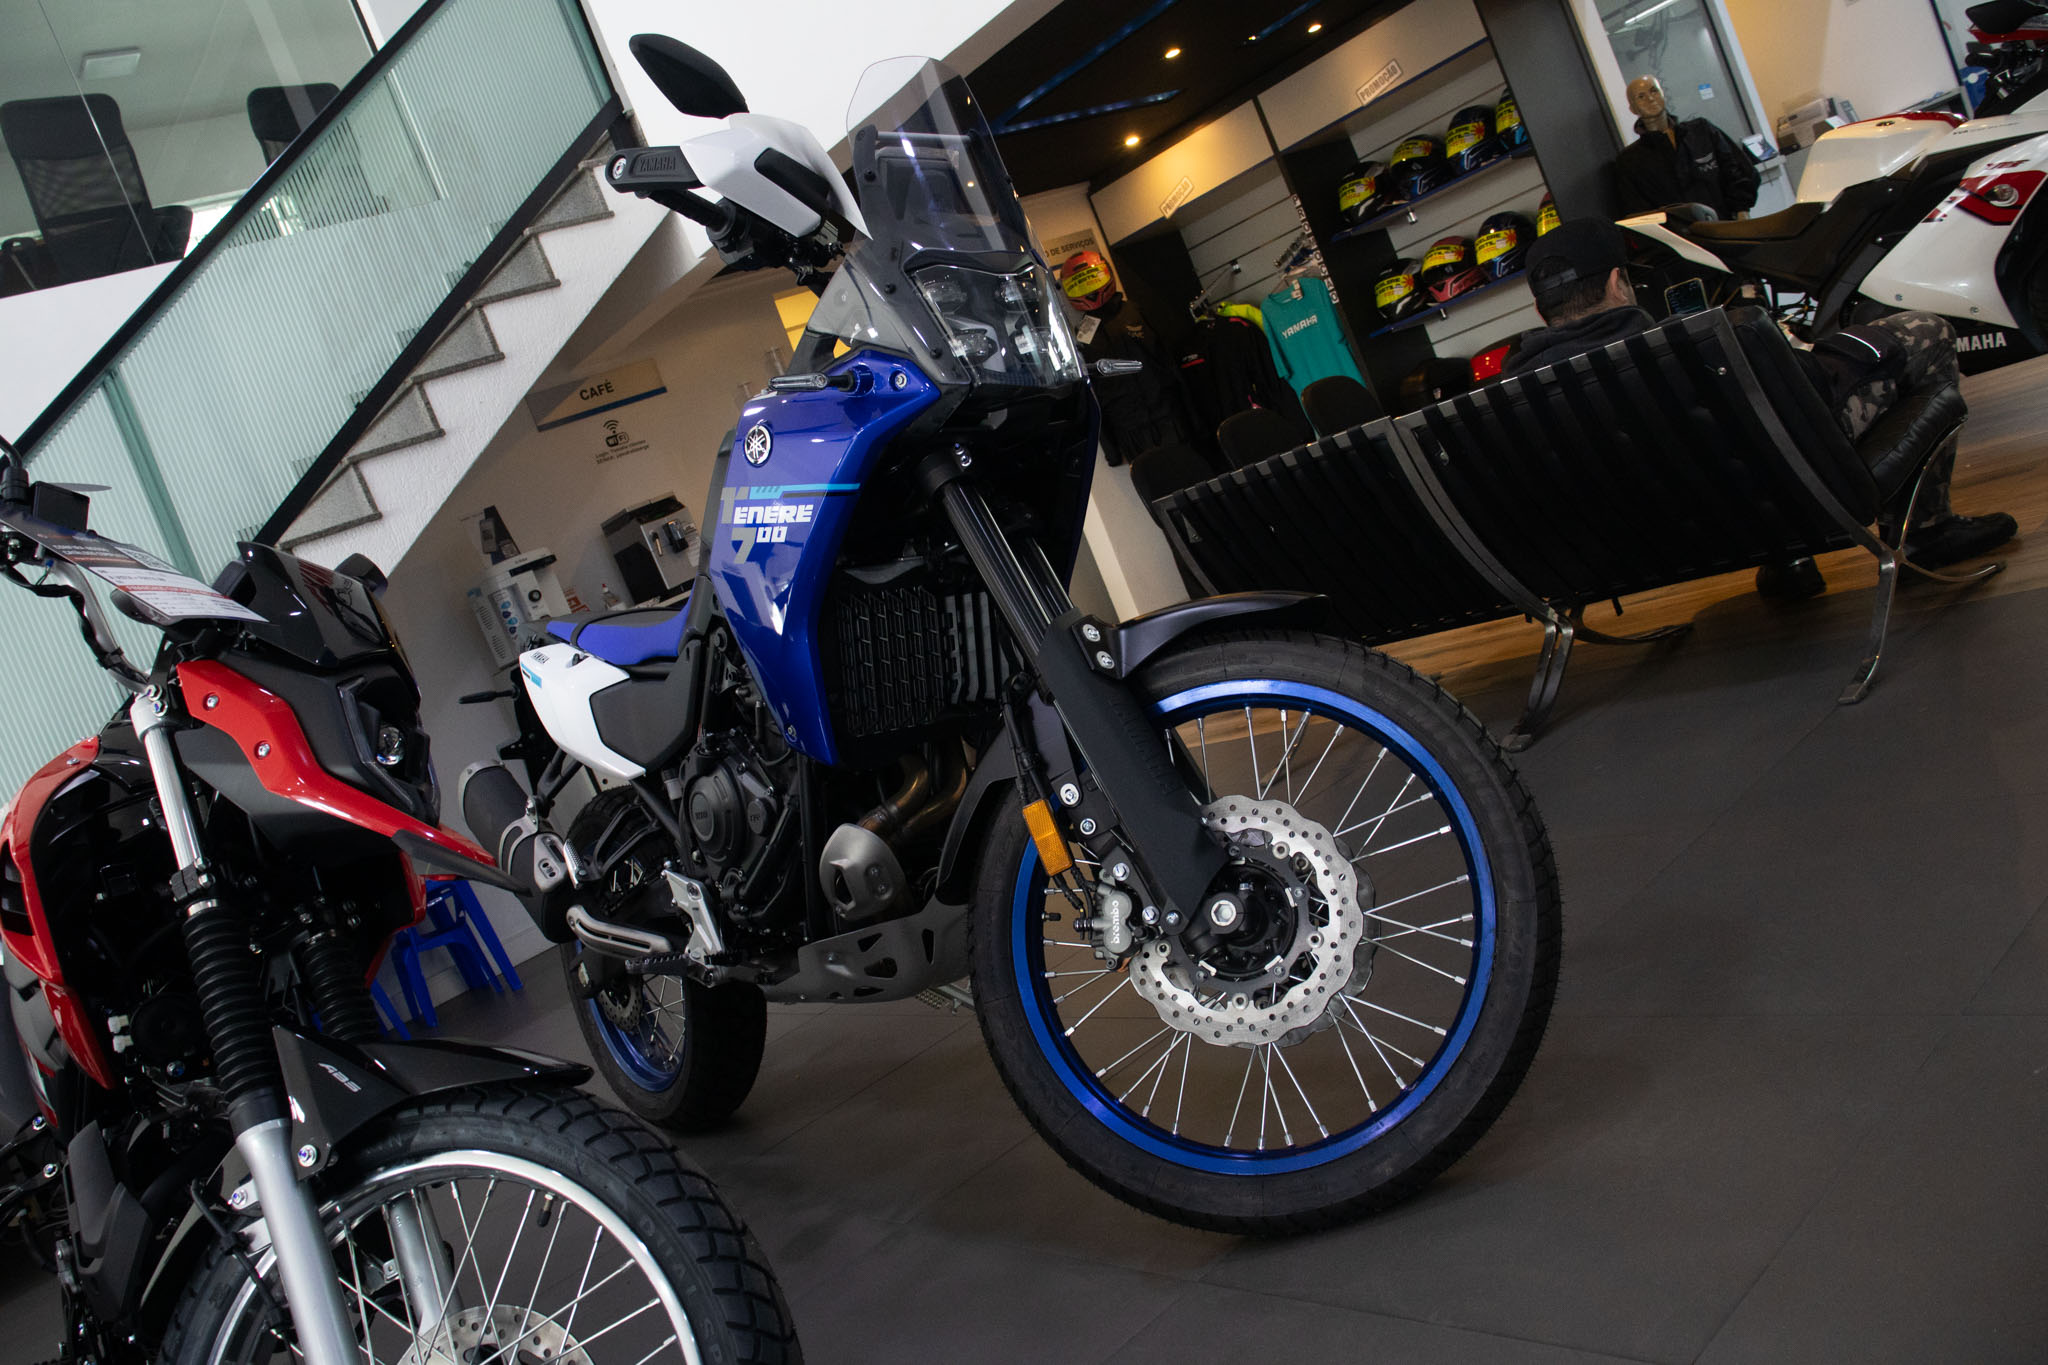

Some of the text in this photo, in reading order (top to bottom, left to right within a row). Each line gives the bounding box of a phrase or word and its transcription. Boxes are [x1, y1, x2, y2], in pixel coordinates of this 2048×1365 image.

[1359, 63, 1399, 102] PROMOÇÃO
[640, 156, 676, 172] YAMAHA
[1050, 247, 1061, 256] DE
[1061, 237, 1095, 253] SERVIÇOS
[1281, 314, 1318, 339] YAMAHA
[1956, 331, 2007, 353] MAHA
[579, 379, 615, 401] CAFÉ
[731, 526, 788, 564] 700
[1110, 900, 1120, 944] brembo
[317, 1062, 362, 1093] ABS
